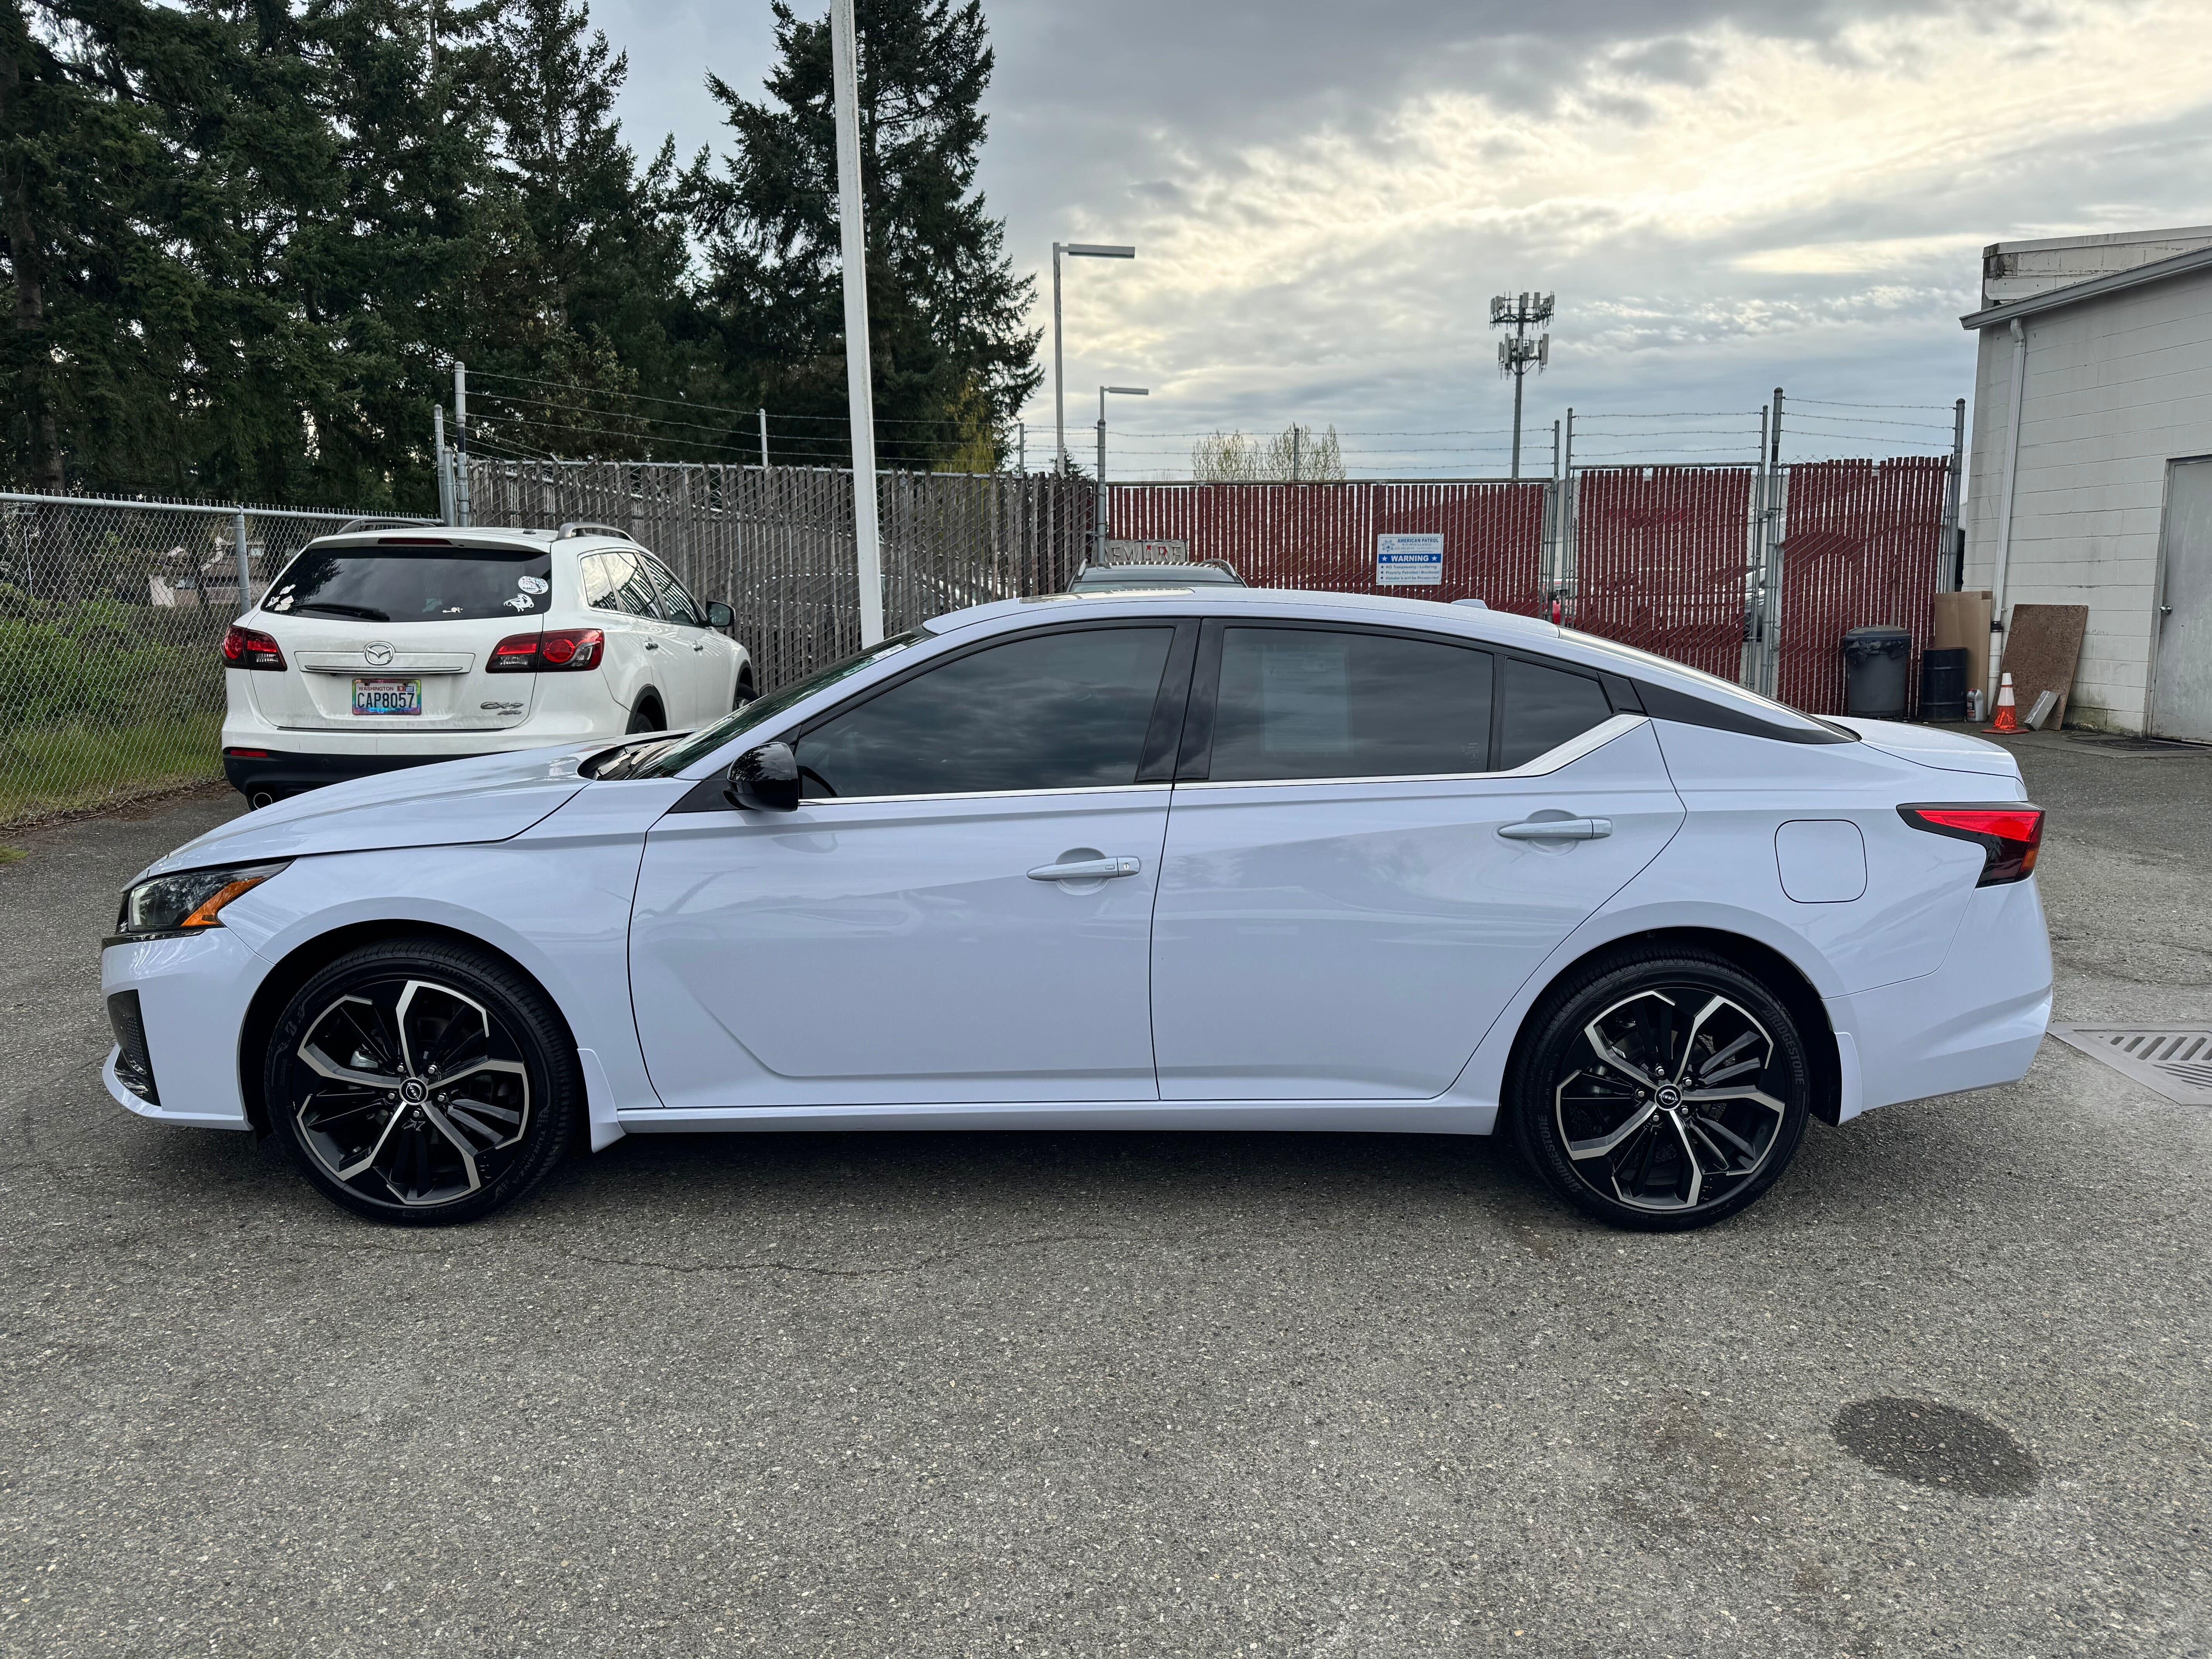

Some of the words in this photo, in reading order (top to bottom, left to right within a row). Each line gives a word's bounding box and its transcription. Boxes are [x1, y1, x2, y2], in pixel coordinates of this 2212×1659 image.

[358, 692, 415, 708] CAP8057
[481, 701, 524, 709] CX-9
[1760, 1007, 1805, 1085] BRIDGESTONE
[1537, 1115, 1583, 1193] BRIDGESTONE
